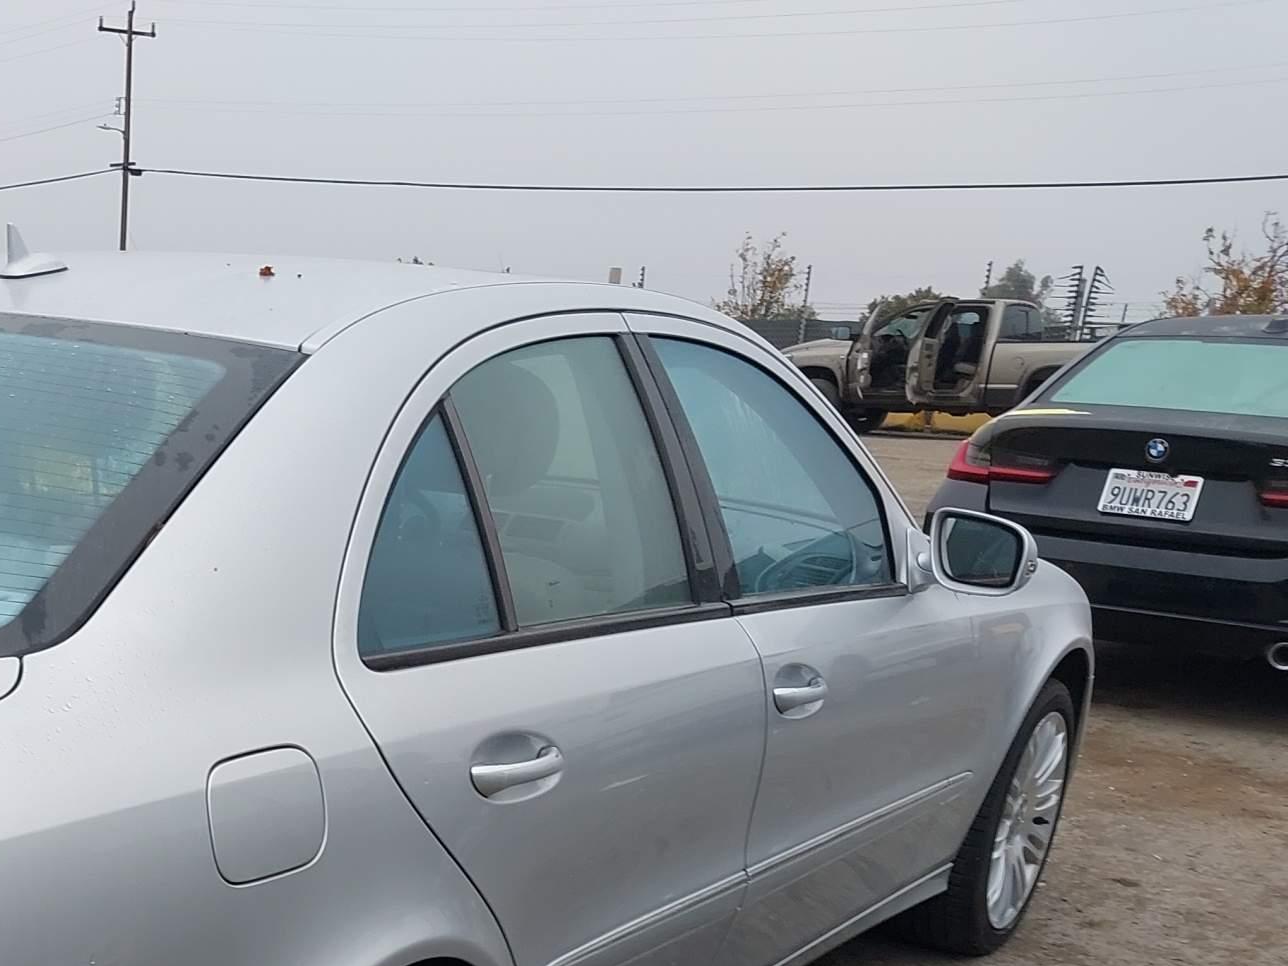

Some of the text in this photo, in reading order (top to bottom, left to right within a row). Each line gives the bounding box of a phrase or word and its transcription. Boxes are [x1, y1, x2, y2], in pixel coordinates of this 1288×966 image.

[1107, 486, 1190, 512] 9UWR763
[1102, 503, 1187, 520] BMW SAN RAFAEL
